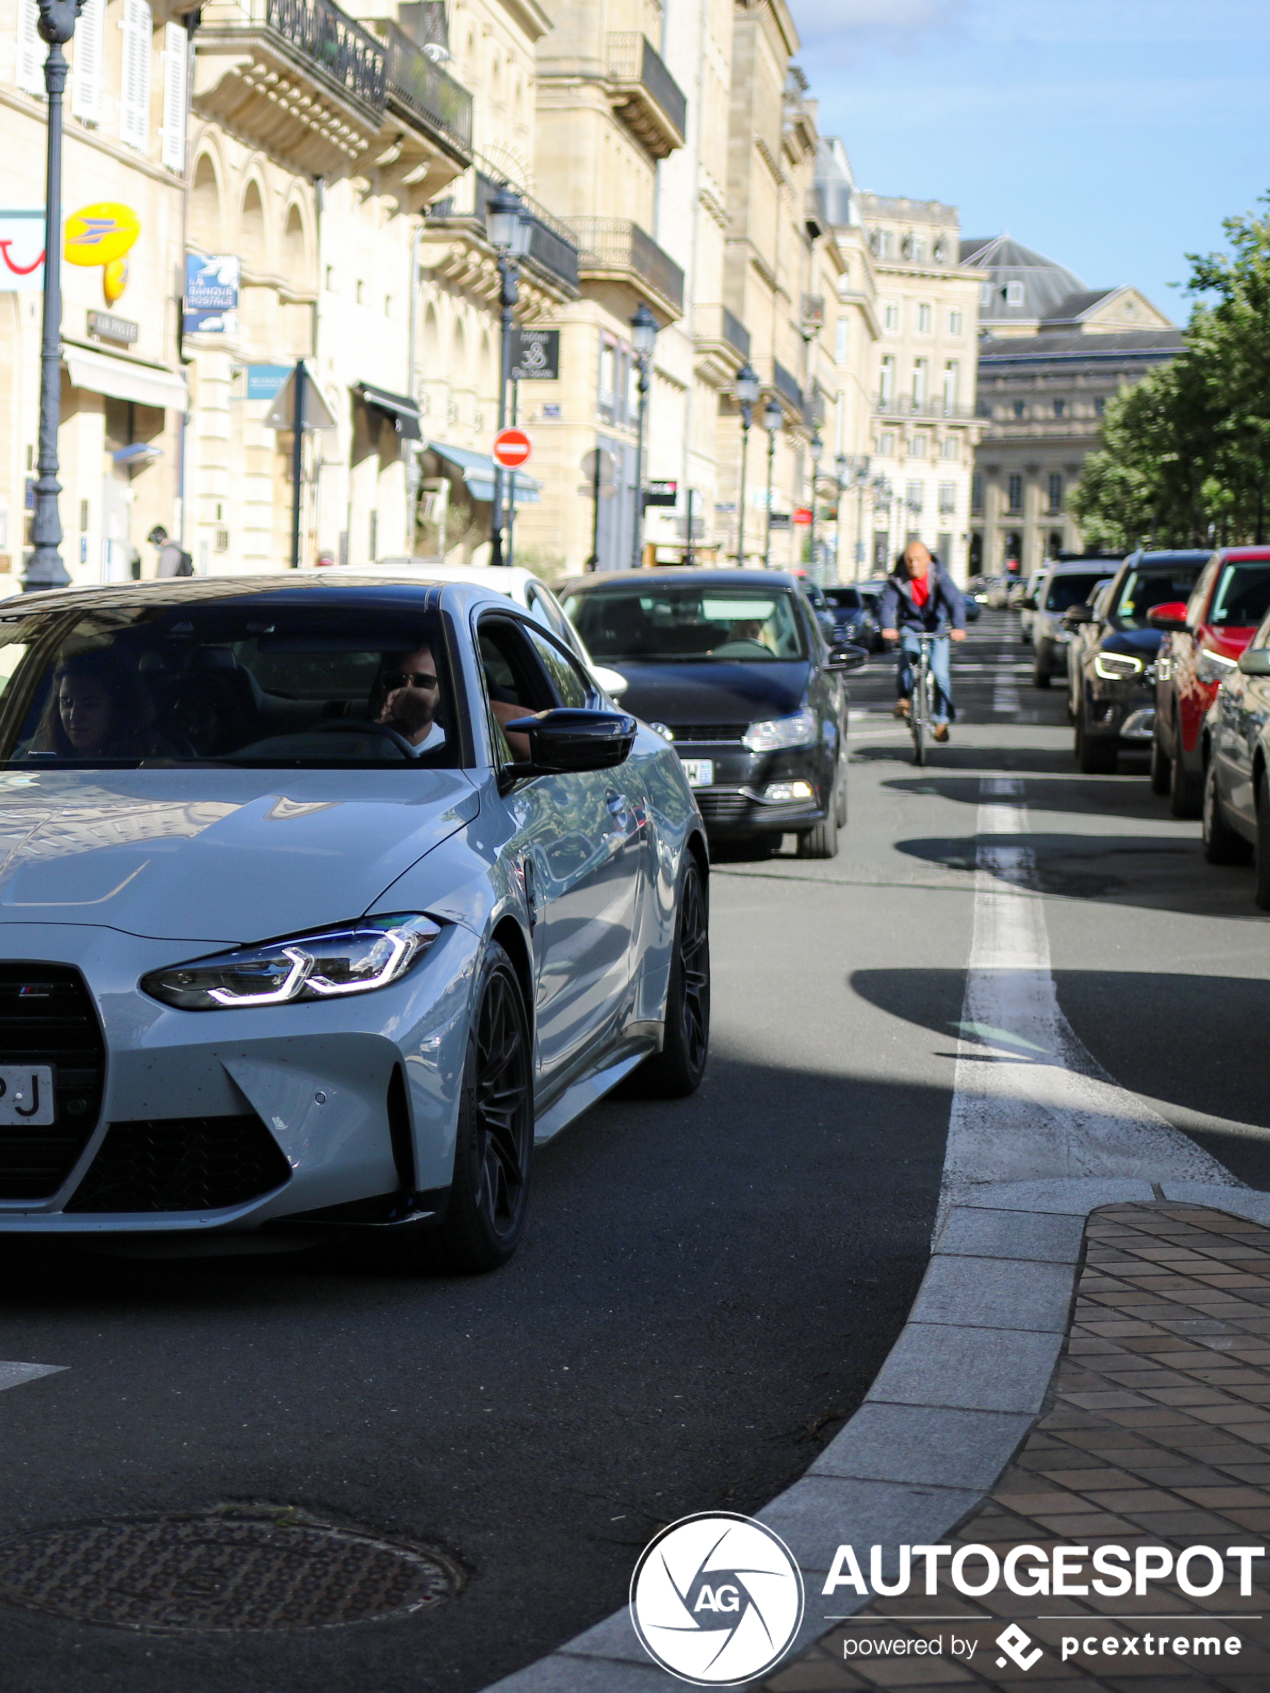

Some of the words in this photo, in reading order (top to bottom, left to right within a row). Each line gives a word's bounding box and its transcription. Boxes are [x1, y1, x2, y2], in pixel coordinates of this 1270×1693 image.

[189, 275, 205, 286] LA
[189, 286, 233, 295] BANQUE
[189, 295, 233, 306] POSTALE
